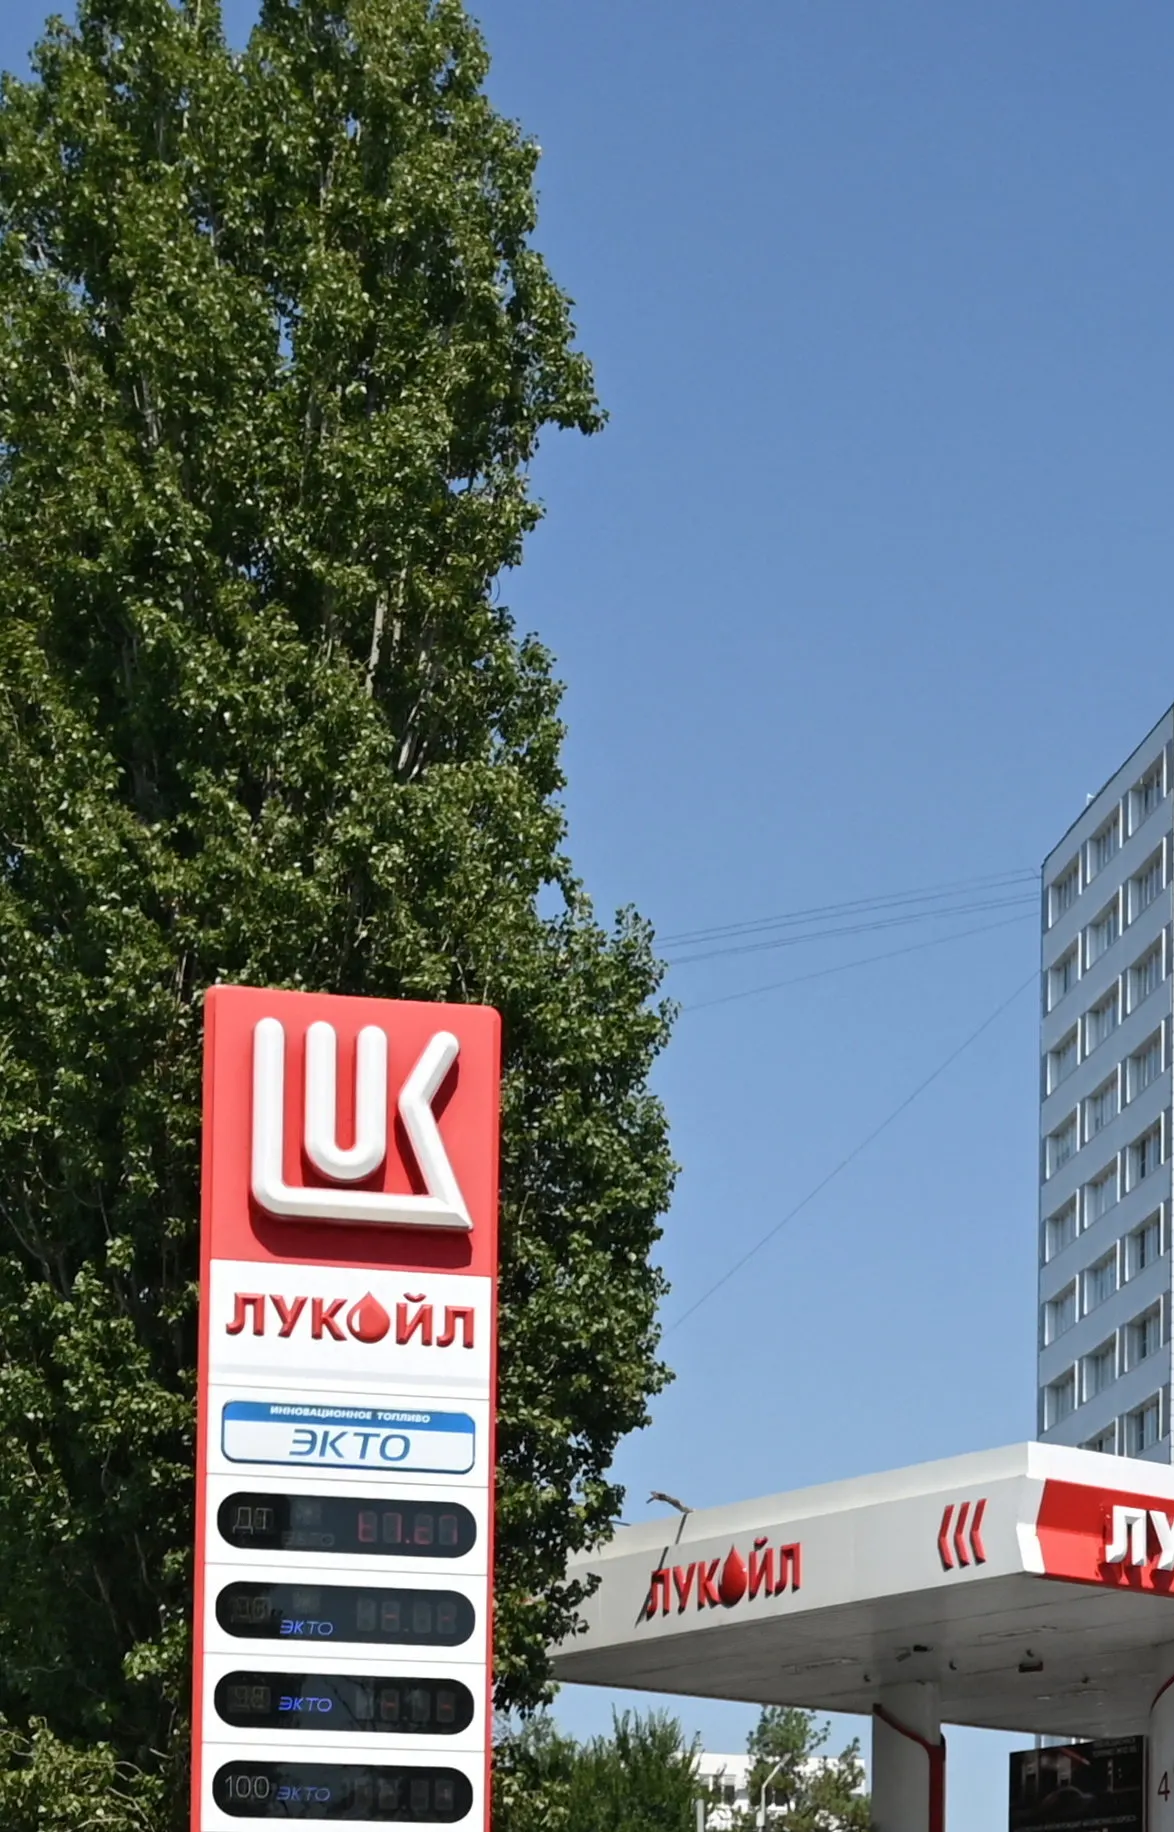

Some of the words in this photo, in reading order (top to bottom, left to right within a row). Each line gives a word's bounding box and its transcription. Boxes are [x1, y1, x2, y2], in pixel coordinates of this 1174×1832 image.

[225, 1290, 475, 1349] ЛУКОЙЛ
[270, 1405, 372, 1421] ИННОВАЦИОННОЕ
[377, 1411, 431, 1424] ТОПЛИВО
[289, 1428, 411, 1462] ЭКТО
[231, 1506, 273, 1534] ДТ
[646, 1536, 803, 1621] ЛУКОЙЛ
[279, 1619, 334, 1636] ЭКТО
[278, 1696, 333, 1713] ЭКТО
[224, 1774, 270, 1801] 100
[276, 1785, 331, 1803] ЭКТО
[1157, 1770, 1171, 1802] 4
